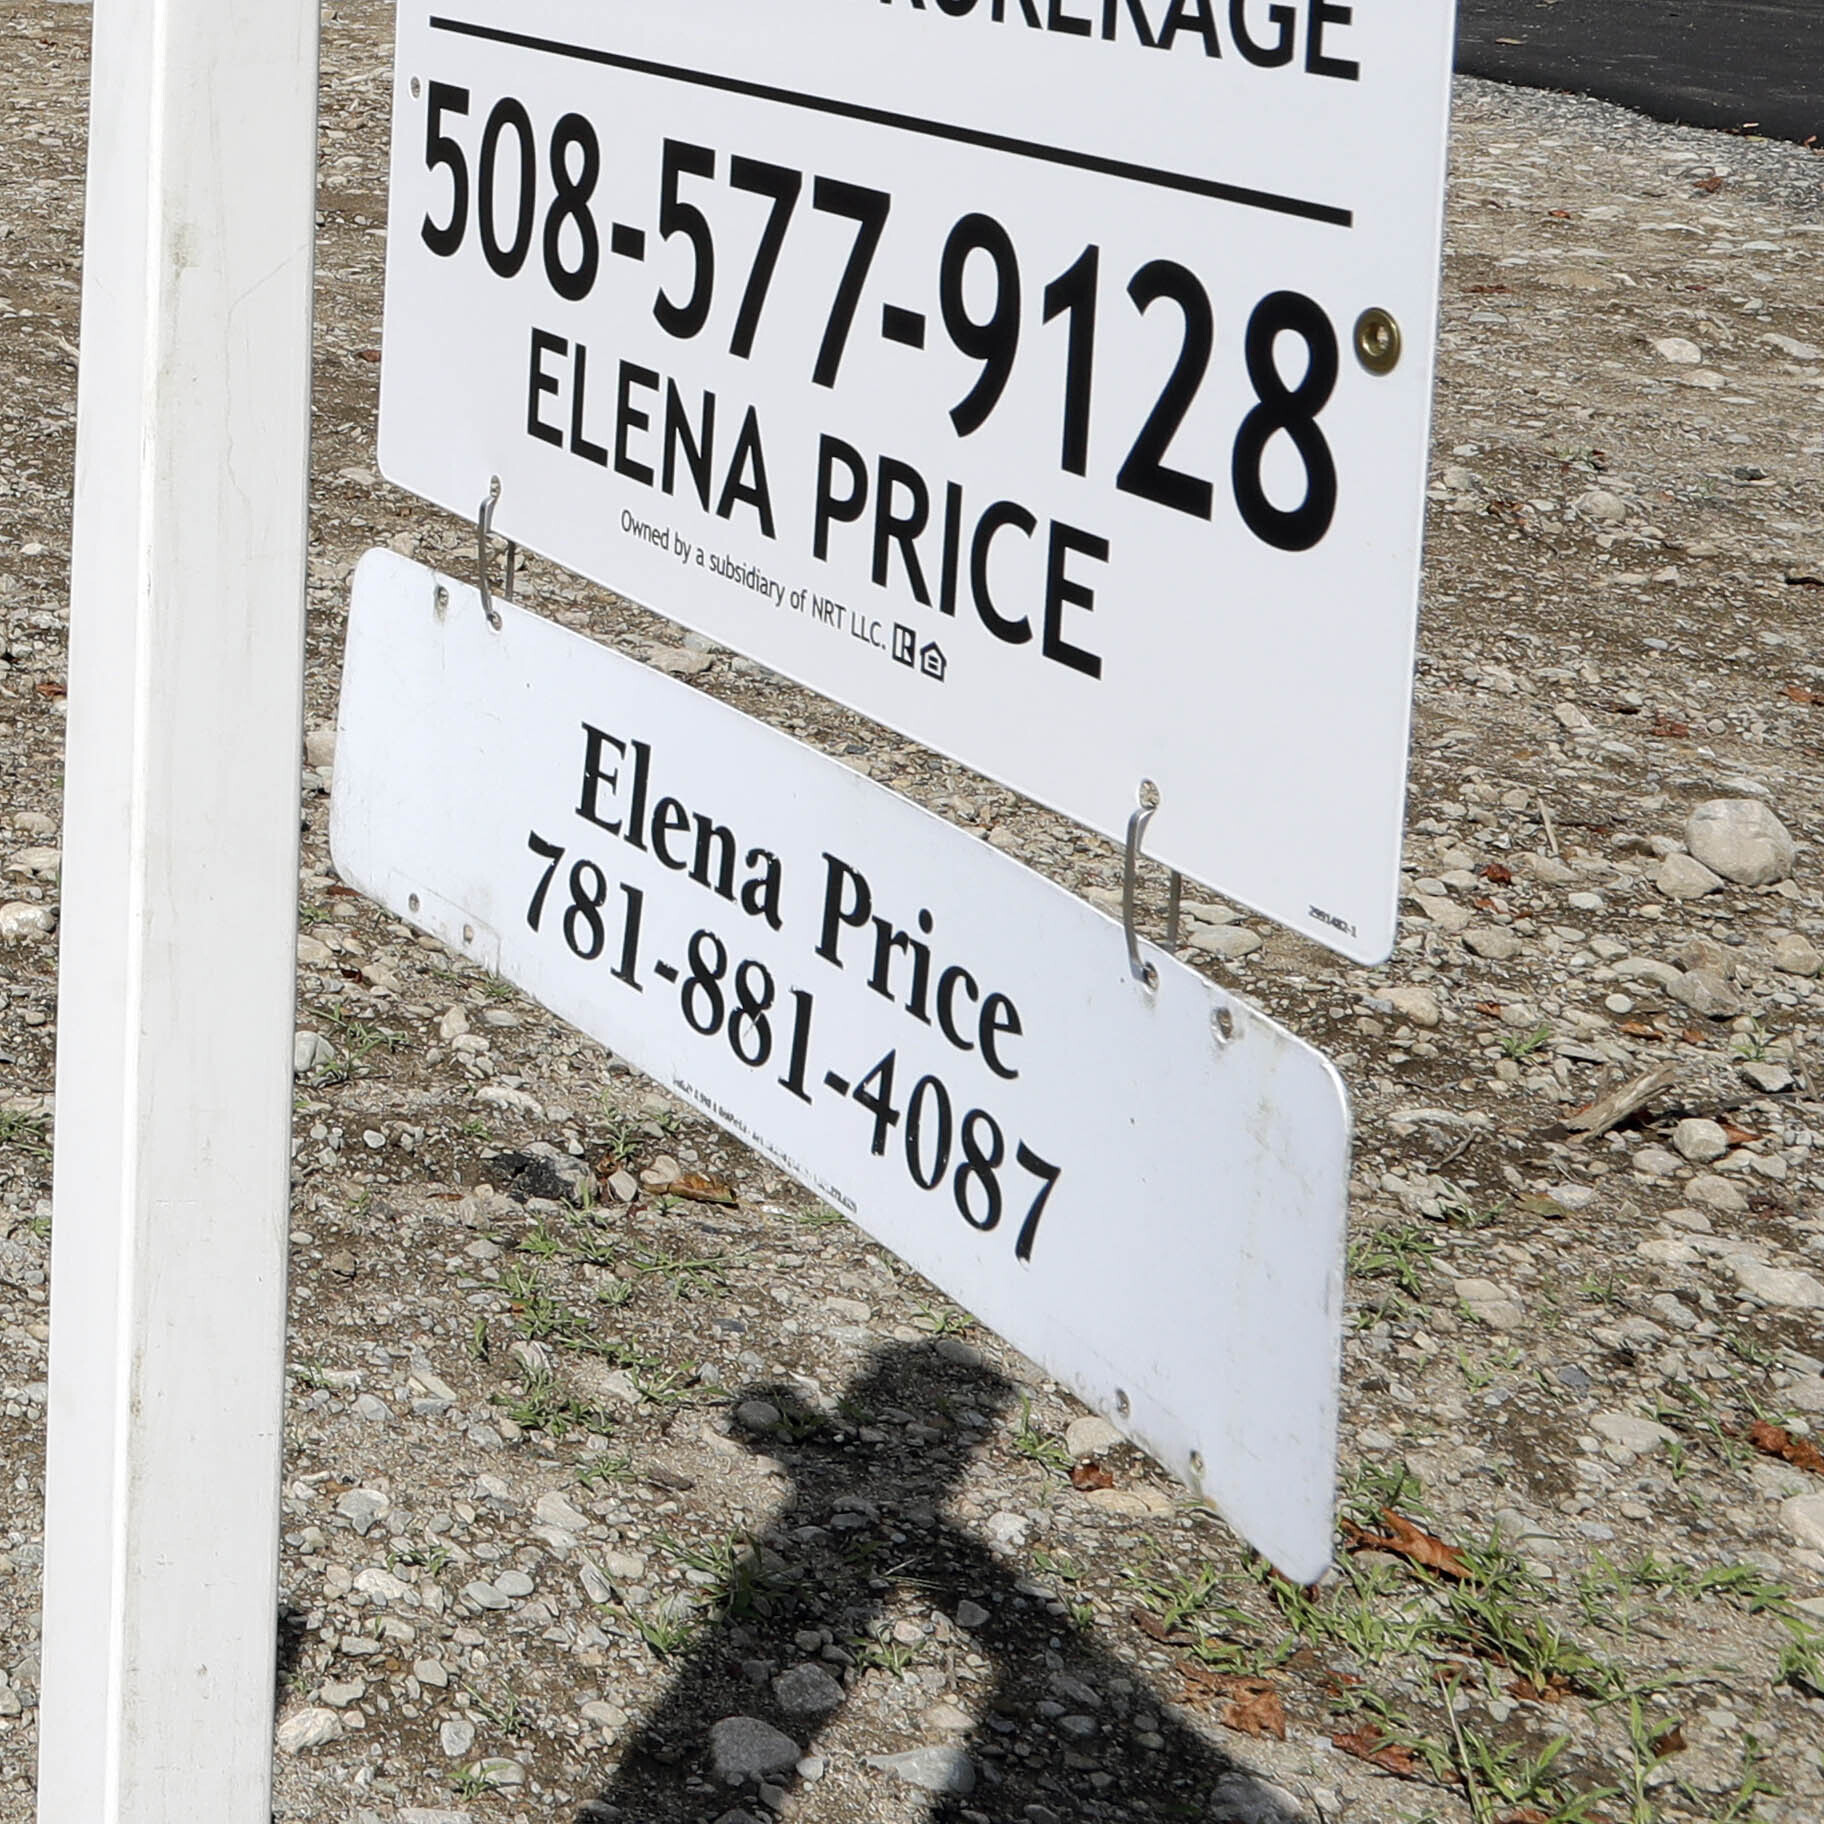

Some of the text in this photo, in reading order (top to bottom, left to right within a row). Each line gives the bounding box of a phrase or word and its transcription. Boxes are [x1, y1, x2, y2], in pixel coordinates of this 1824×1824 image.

[422, 81, 1338, 551] 508-577-9128
[528, 328, 1109, 679] ELENA PRICE
[620, 509, 886, 650] Owned by a subsidiary of NRT LLC.
[526, 829, 1061, 1263] 781-881-4087
[576, 723, 1022, 1079] Elena Price
